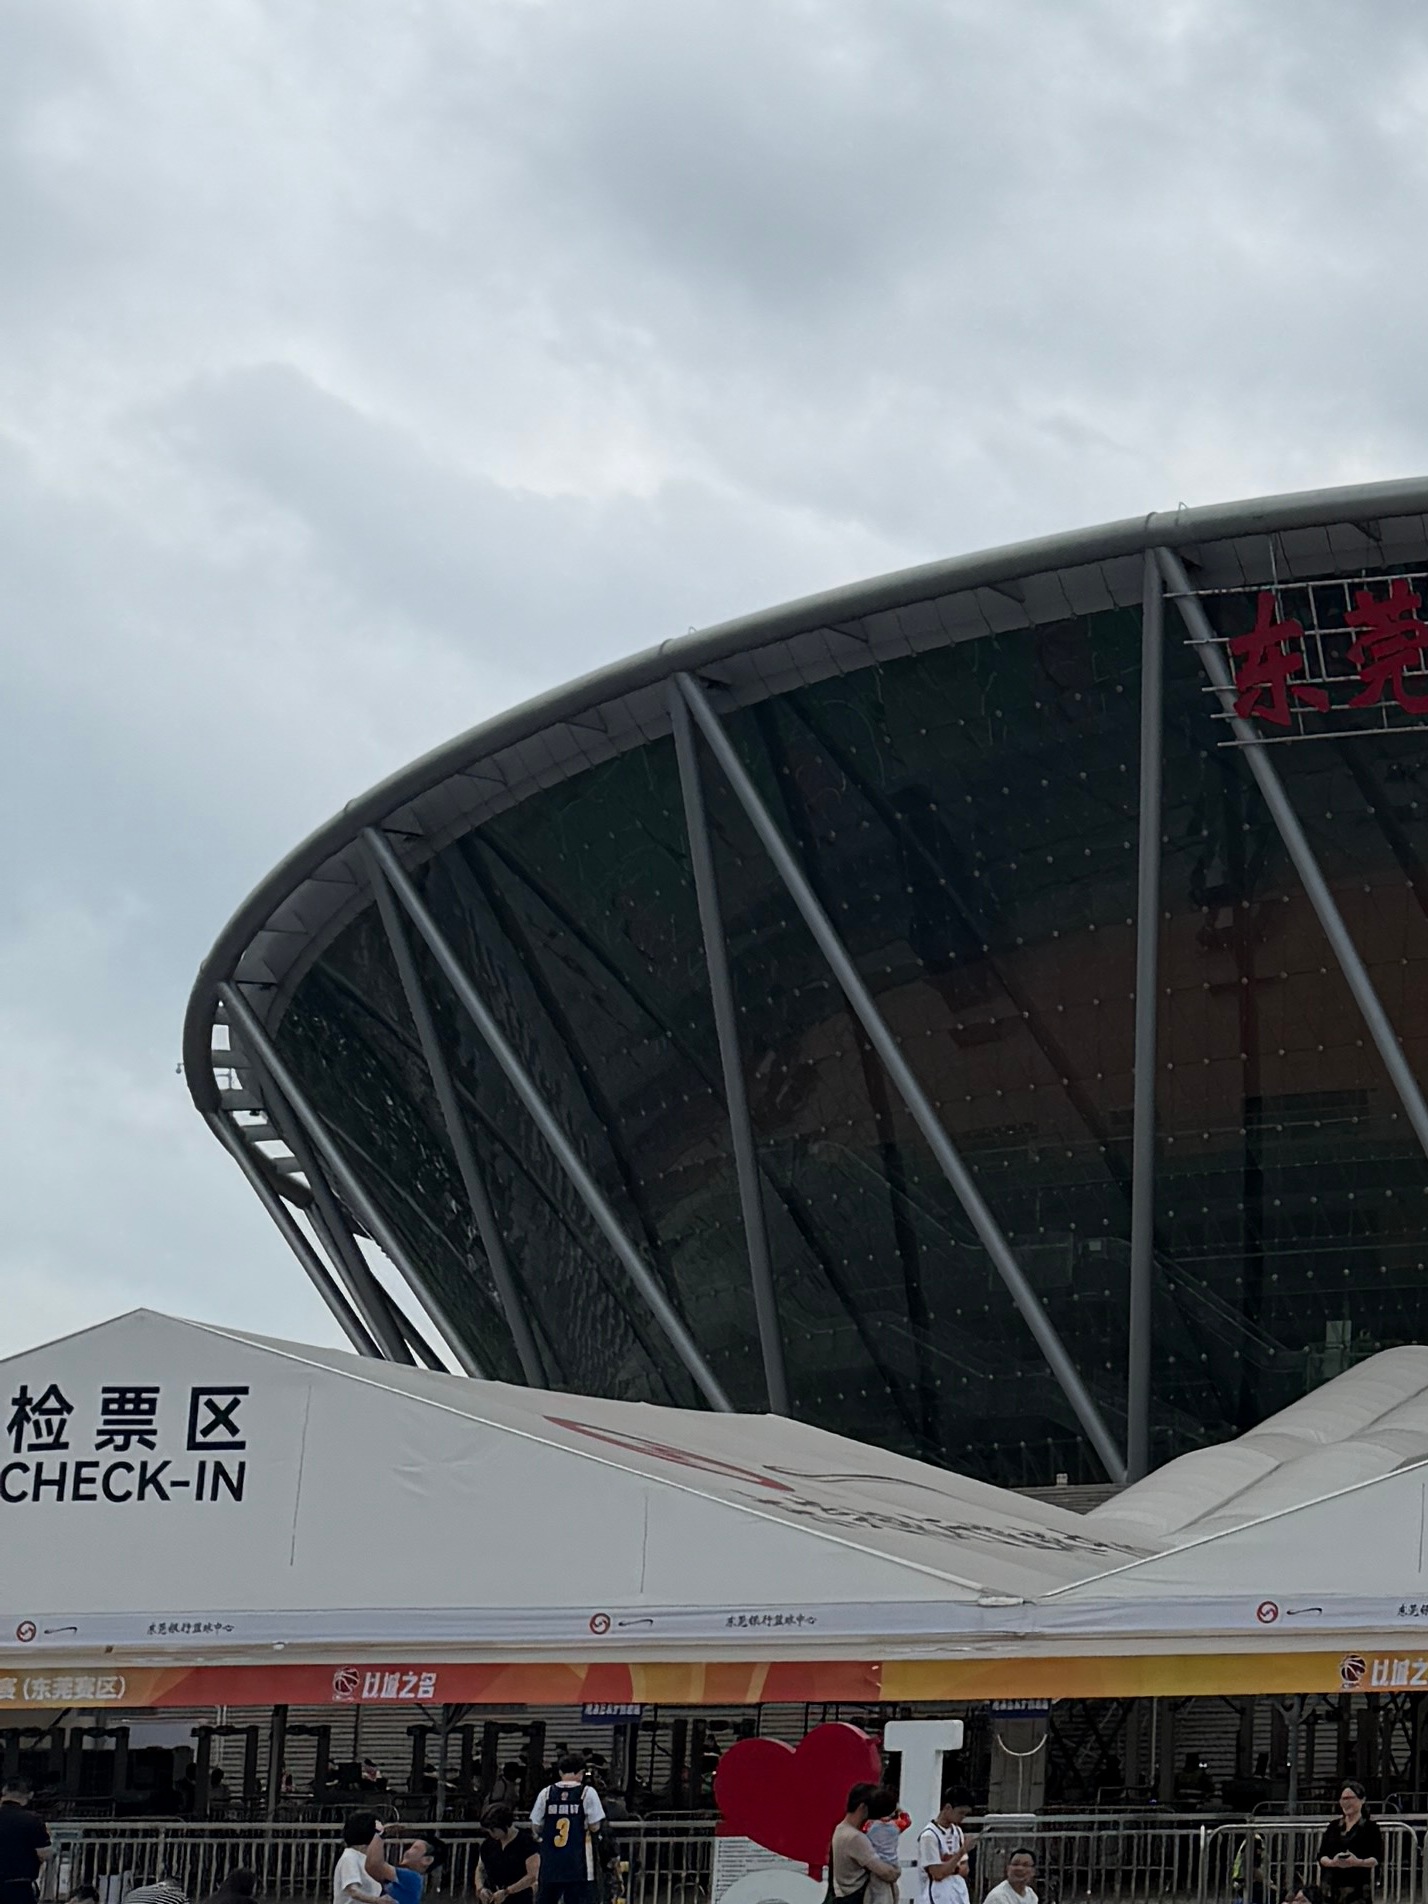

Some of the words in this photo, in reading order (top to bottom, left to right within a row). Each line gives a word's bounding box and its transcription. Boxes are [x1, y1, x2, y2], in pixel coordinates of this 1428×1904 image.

[7, 1384, 249, 1453] 检票区
[0, 1460, 246, 1503] CHECK-IN
[553, 1817, 571, 1848] 3
